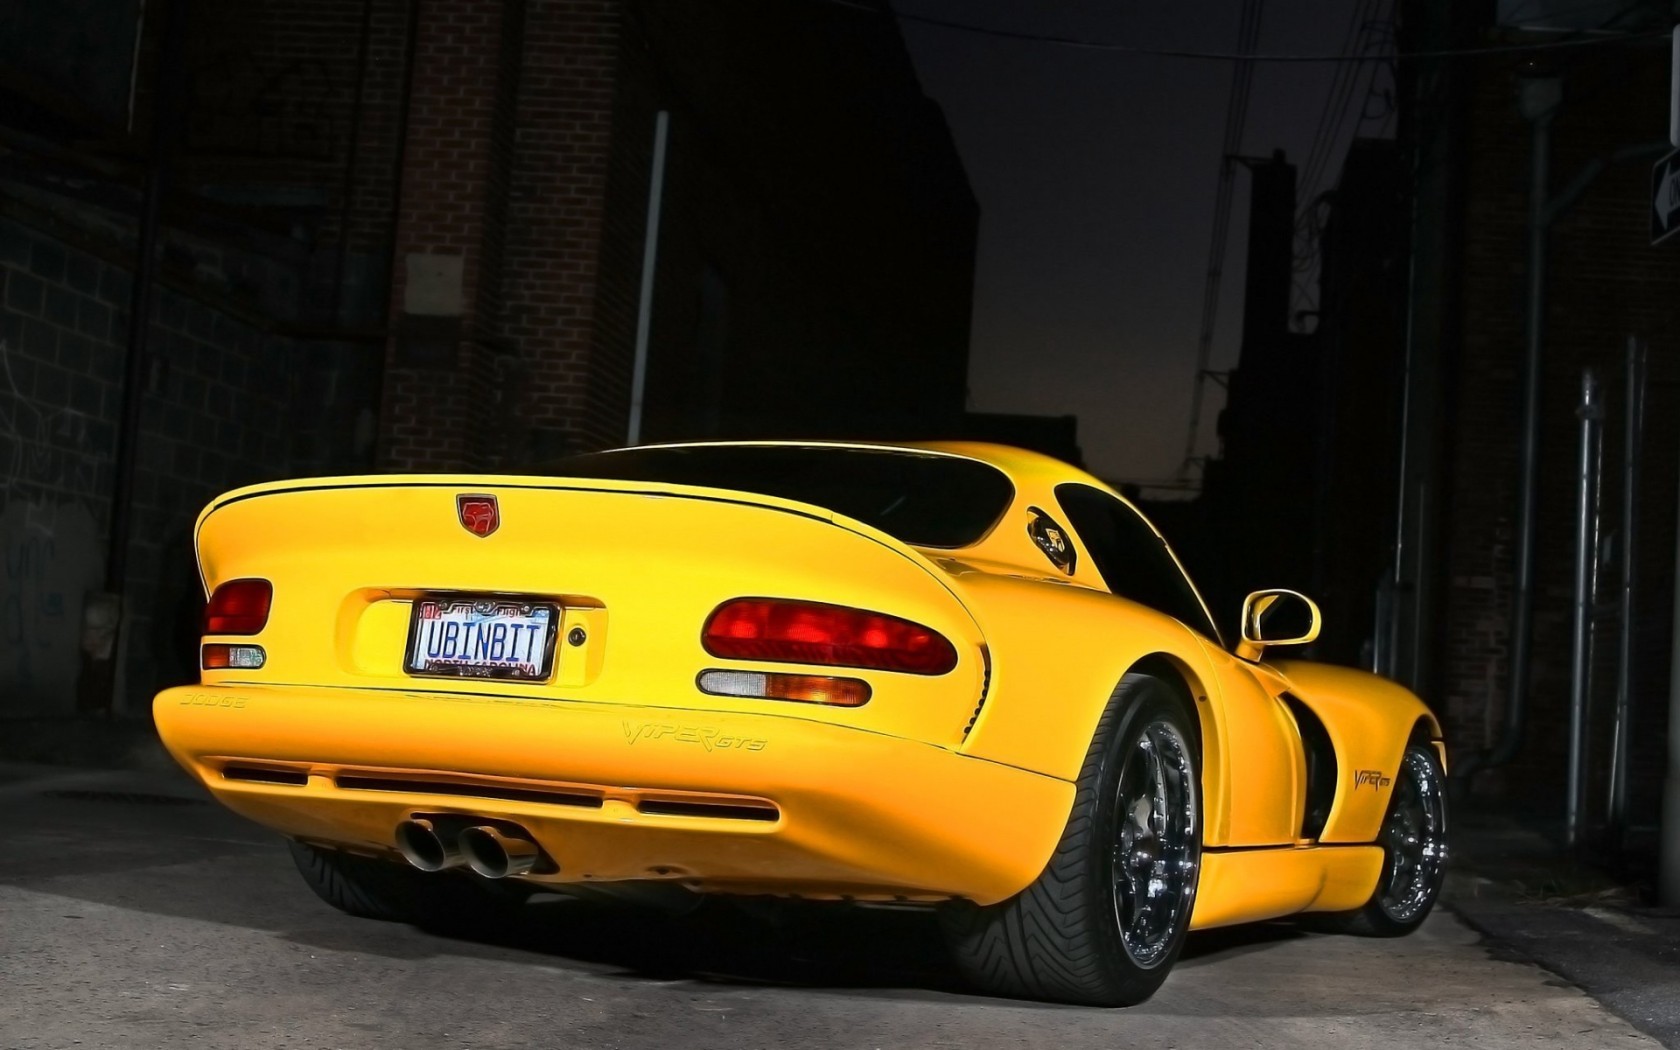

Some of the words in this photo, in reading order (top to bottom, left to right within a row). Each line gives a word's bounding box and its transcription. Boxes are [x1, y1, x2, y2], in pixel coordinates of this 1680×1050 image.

[427, 621, 541, 662] UBINBIT
[180, 693, 249, 709] DODGE
[622, 719, 720, 752] VIPER
[714, 737, 768, 751] GTS
